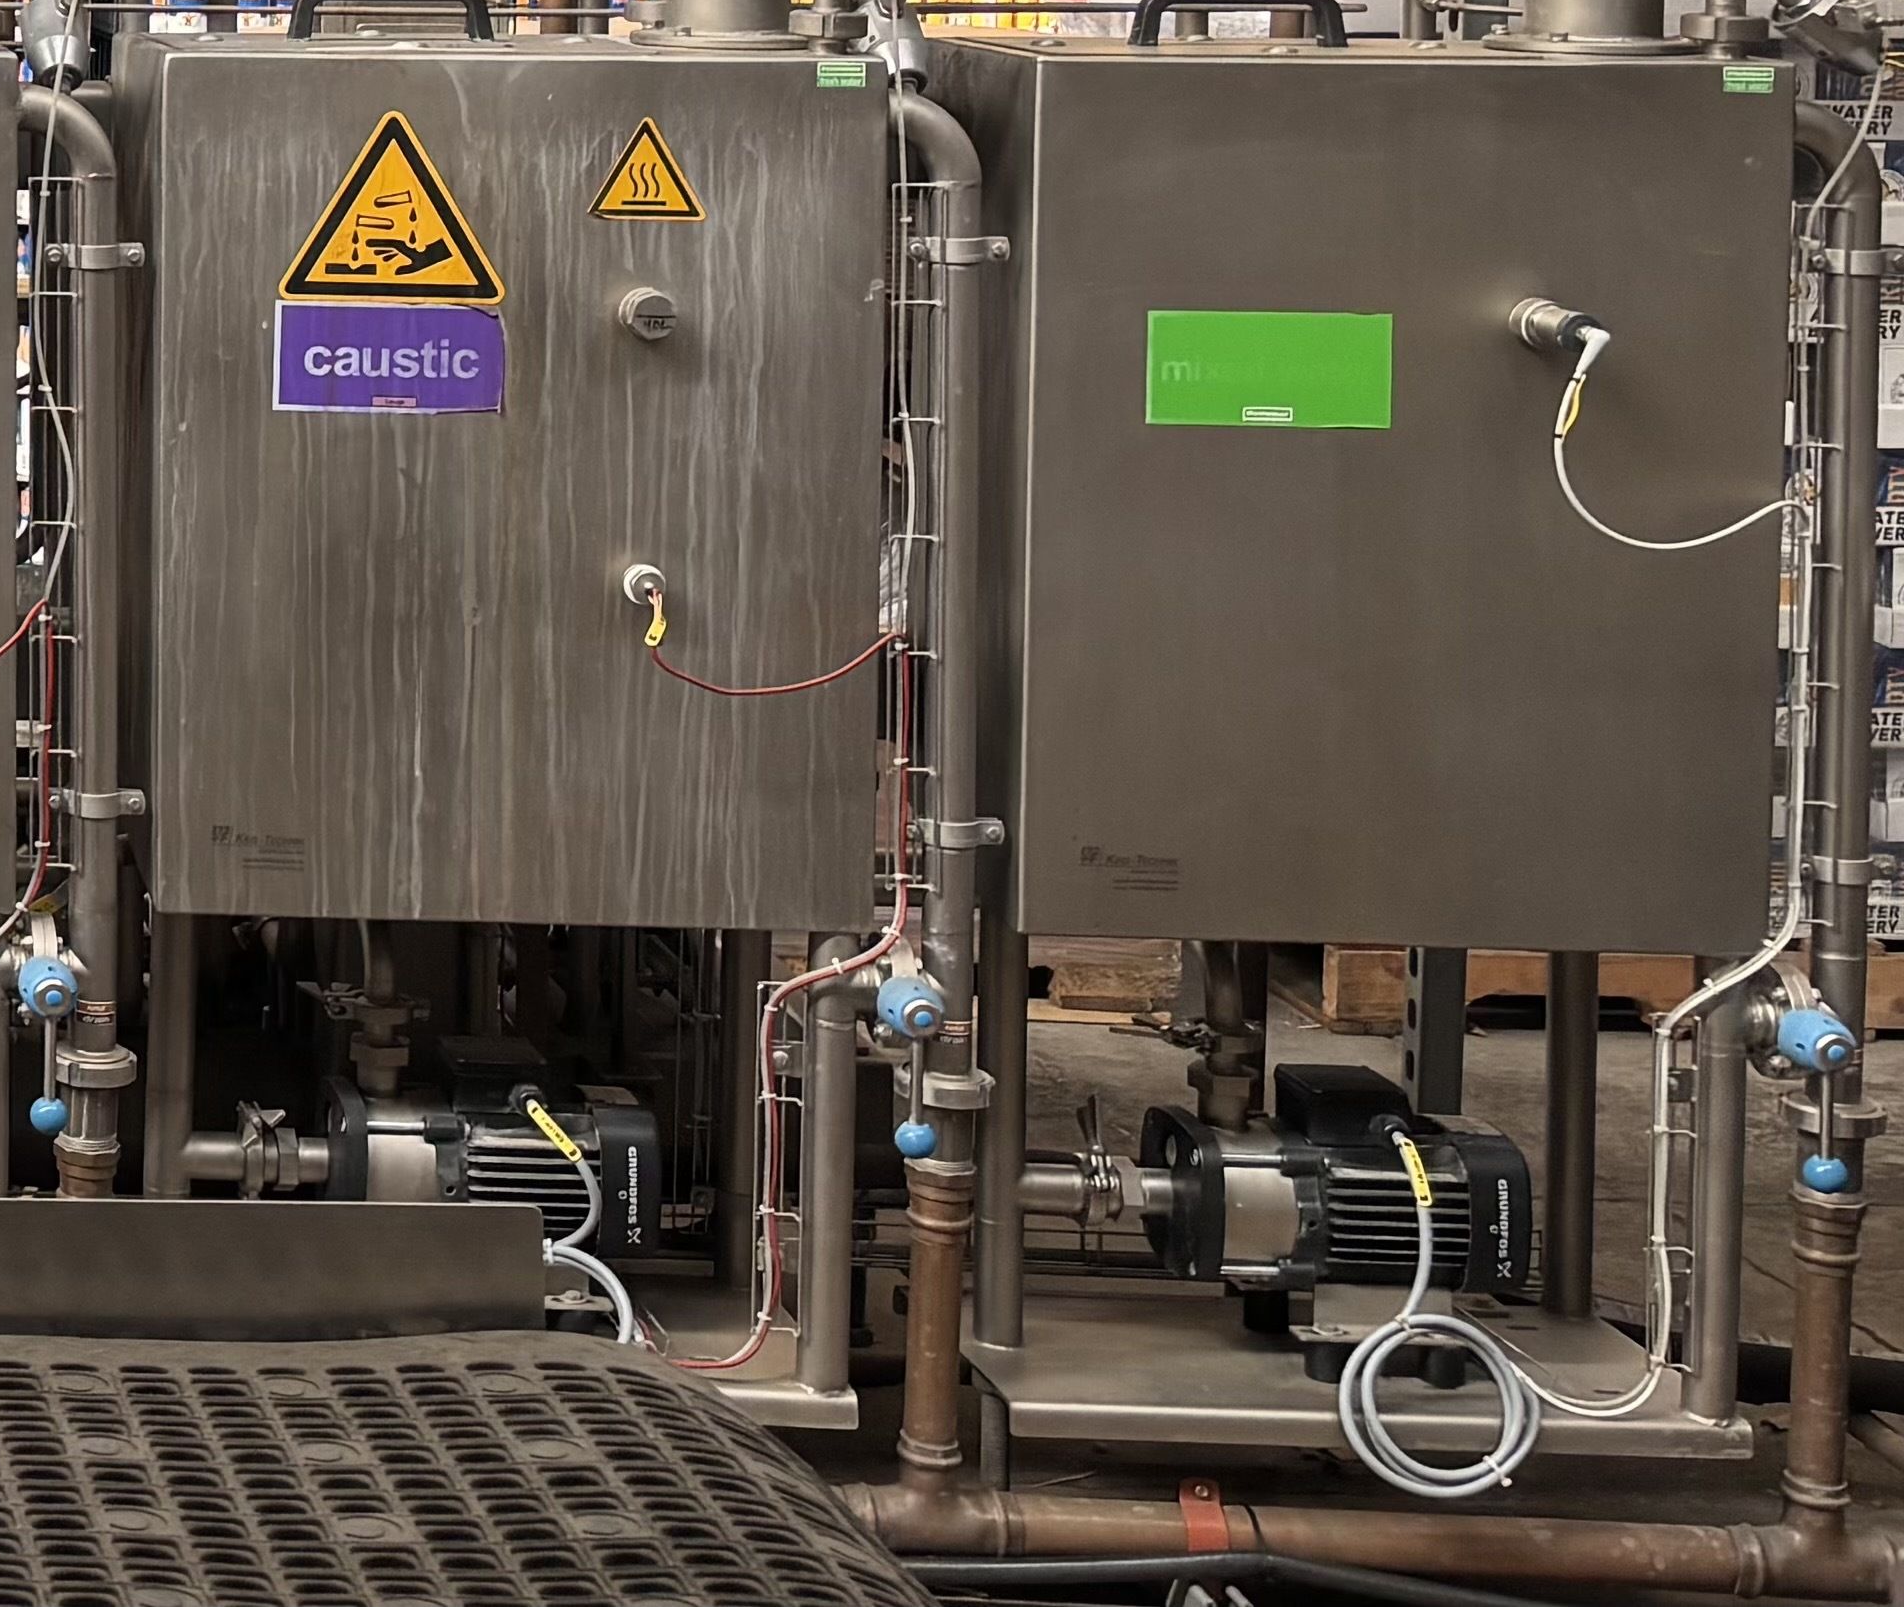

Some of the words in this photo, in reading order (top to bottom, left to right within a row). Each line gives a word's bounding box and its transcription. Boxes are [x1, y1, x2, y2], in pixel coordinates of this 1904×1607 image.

[304, 339, 480, 379] caustic
[628, 1146, 638, 1224] GRUNDFOS
[1497, 1179, 1509, 1258] GRUNDFOS
